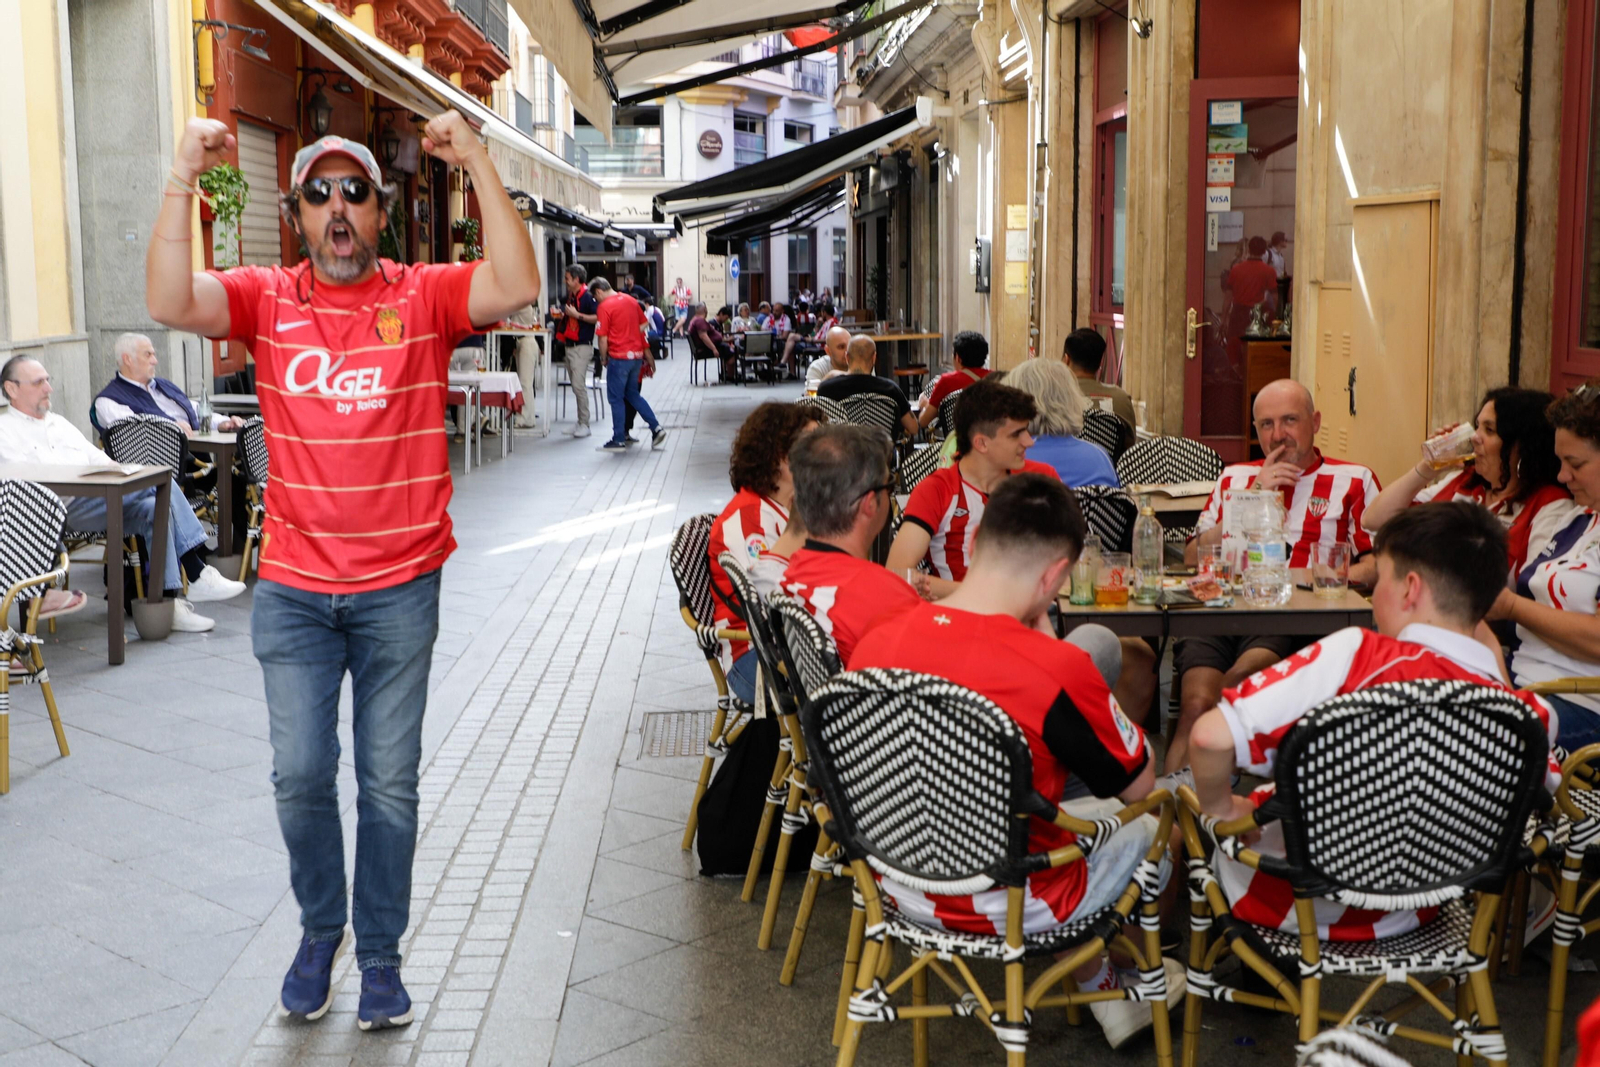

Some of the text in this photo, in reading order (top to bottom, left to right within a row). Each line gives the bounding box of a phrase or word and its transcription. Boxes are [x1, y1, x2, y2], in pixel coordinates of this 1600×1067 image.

[1210, 195, 1229, 203] VISA
[702, 274, 724, 283] Brasas
[336, 401, 353, 415] by
